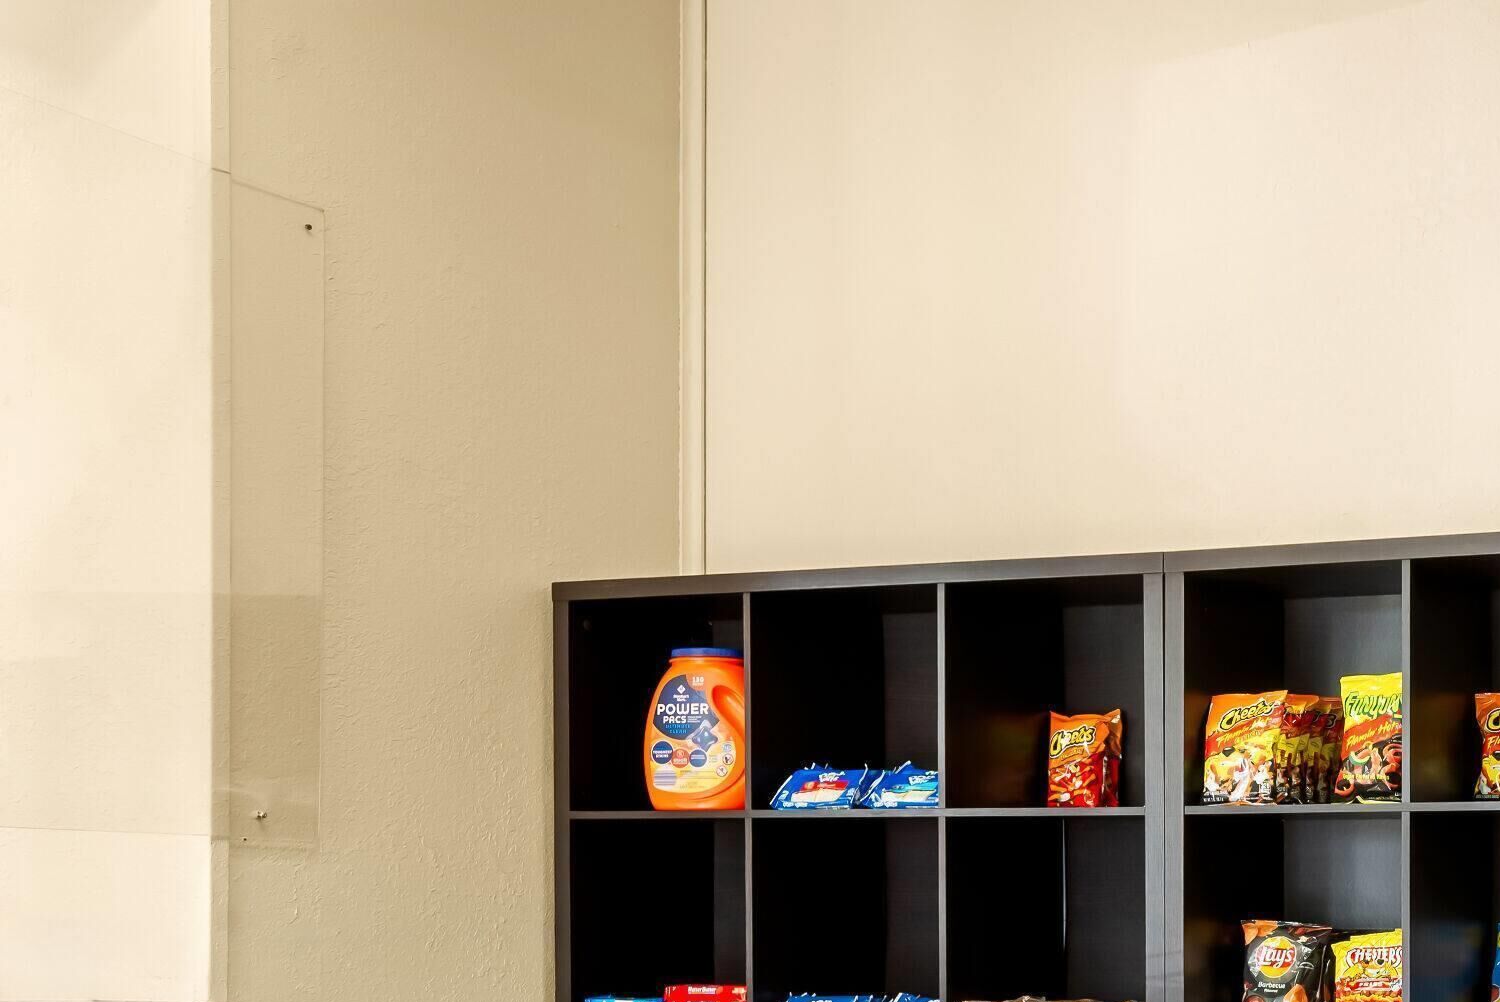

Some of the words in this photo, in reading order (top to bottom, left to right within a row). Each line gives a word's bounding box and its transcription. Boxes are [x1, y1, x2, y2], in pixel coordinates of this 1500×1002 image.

[657, 703, 709, 716] POWER
[663, 715, 687, 724] PACS
[1257, 981, 1286, 989] Barbecue
